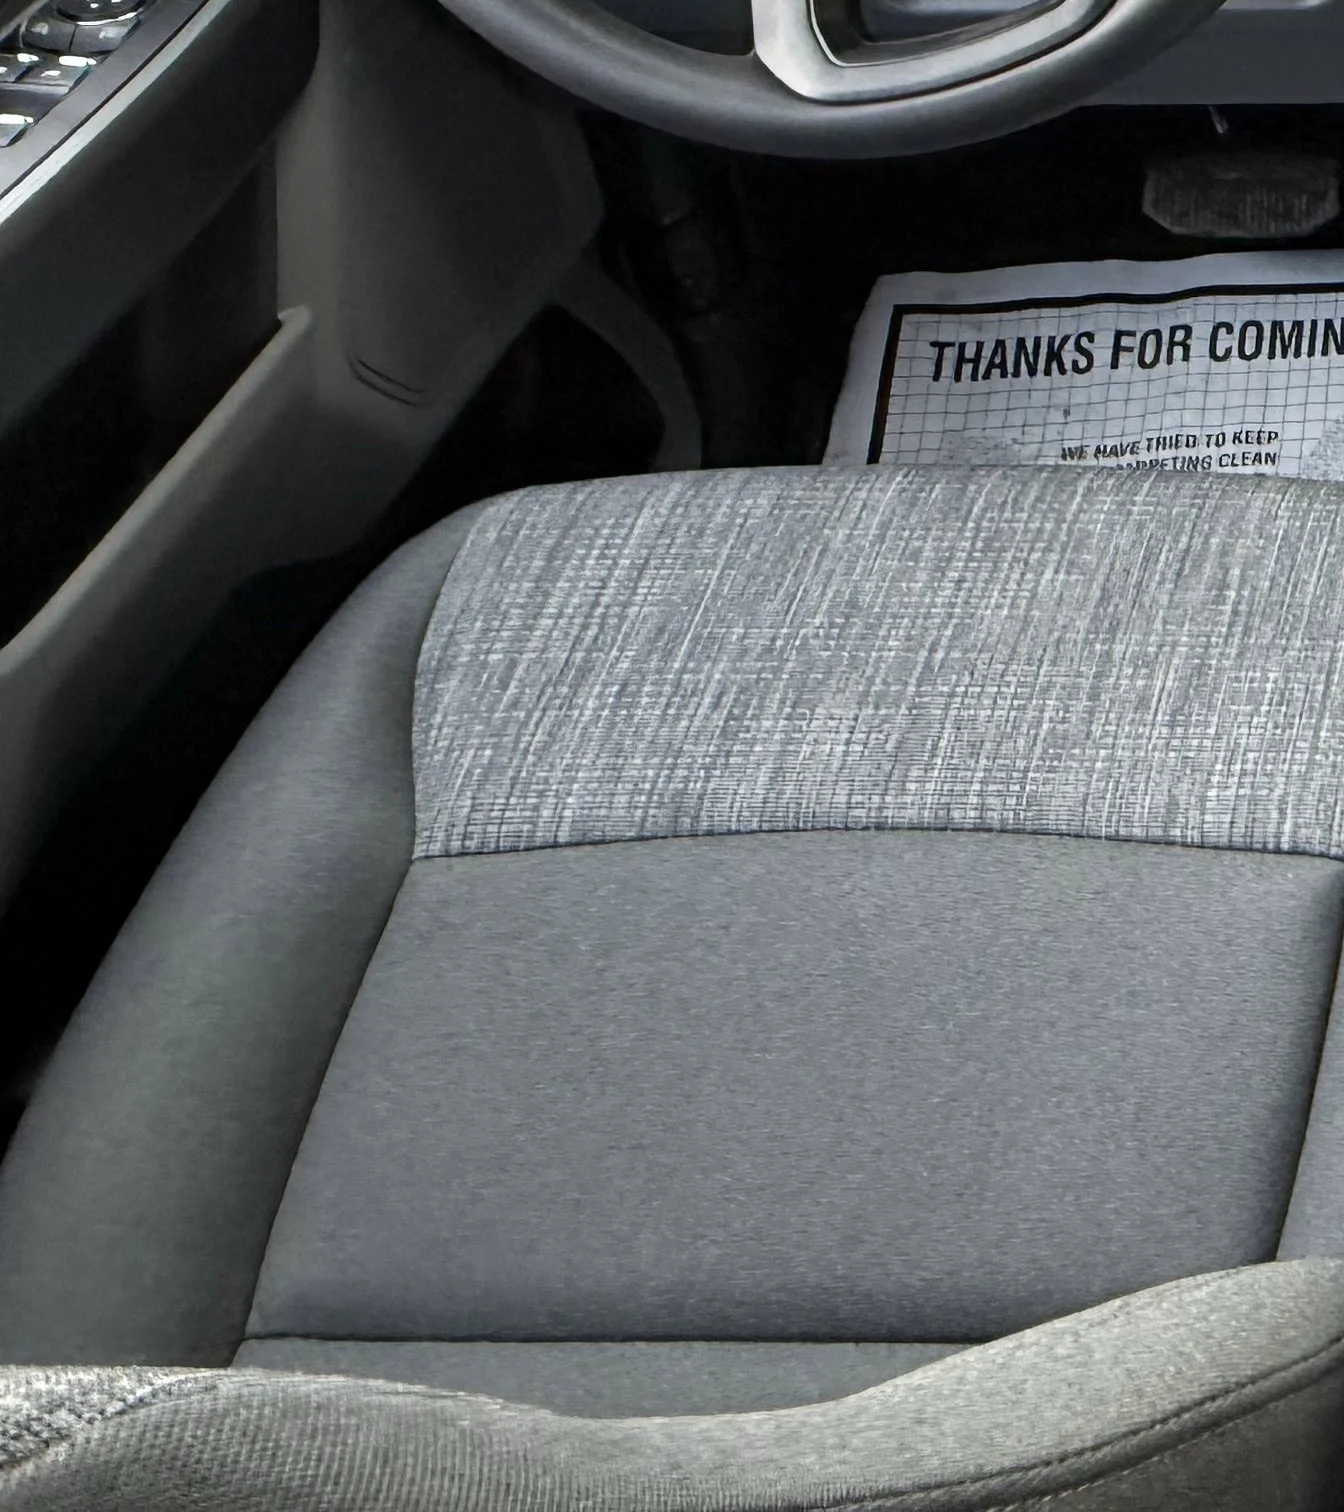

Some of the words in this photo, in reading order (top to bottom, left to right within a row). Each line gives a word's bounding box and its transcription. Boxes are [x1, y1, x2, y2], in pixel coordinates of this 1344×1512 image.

[929, 332, 1094, 383] THANKS
[1111, 322, 1191, 370] FOR
[1093, 441, 1140, 459] HAVE
[1146, 434, 1197, 454] TRIED
[1206, 432, 1226, 448] TO
[1232, 430, 1279, 445] KEEP
[1219, 451, 1278, 468] CLEAN
